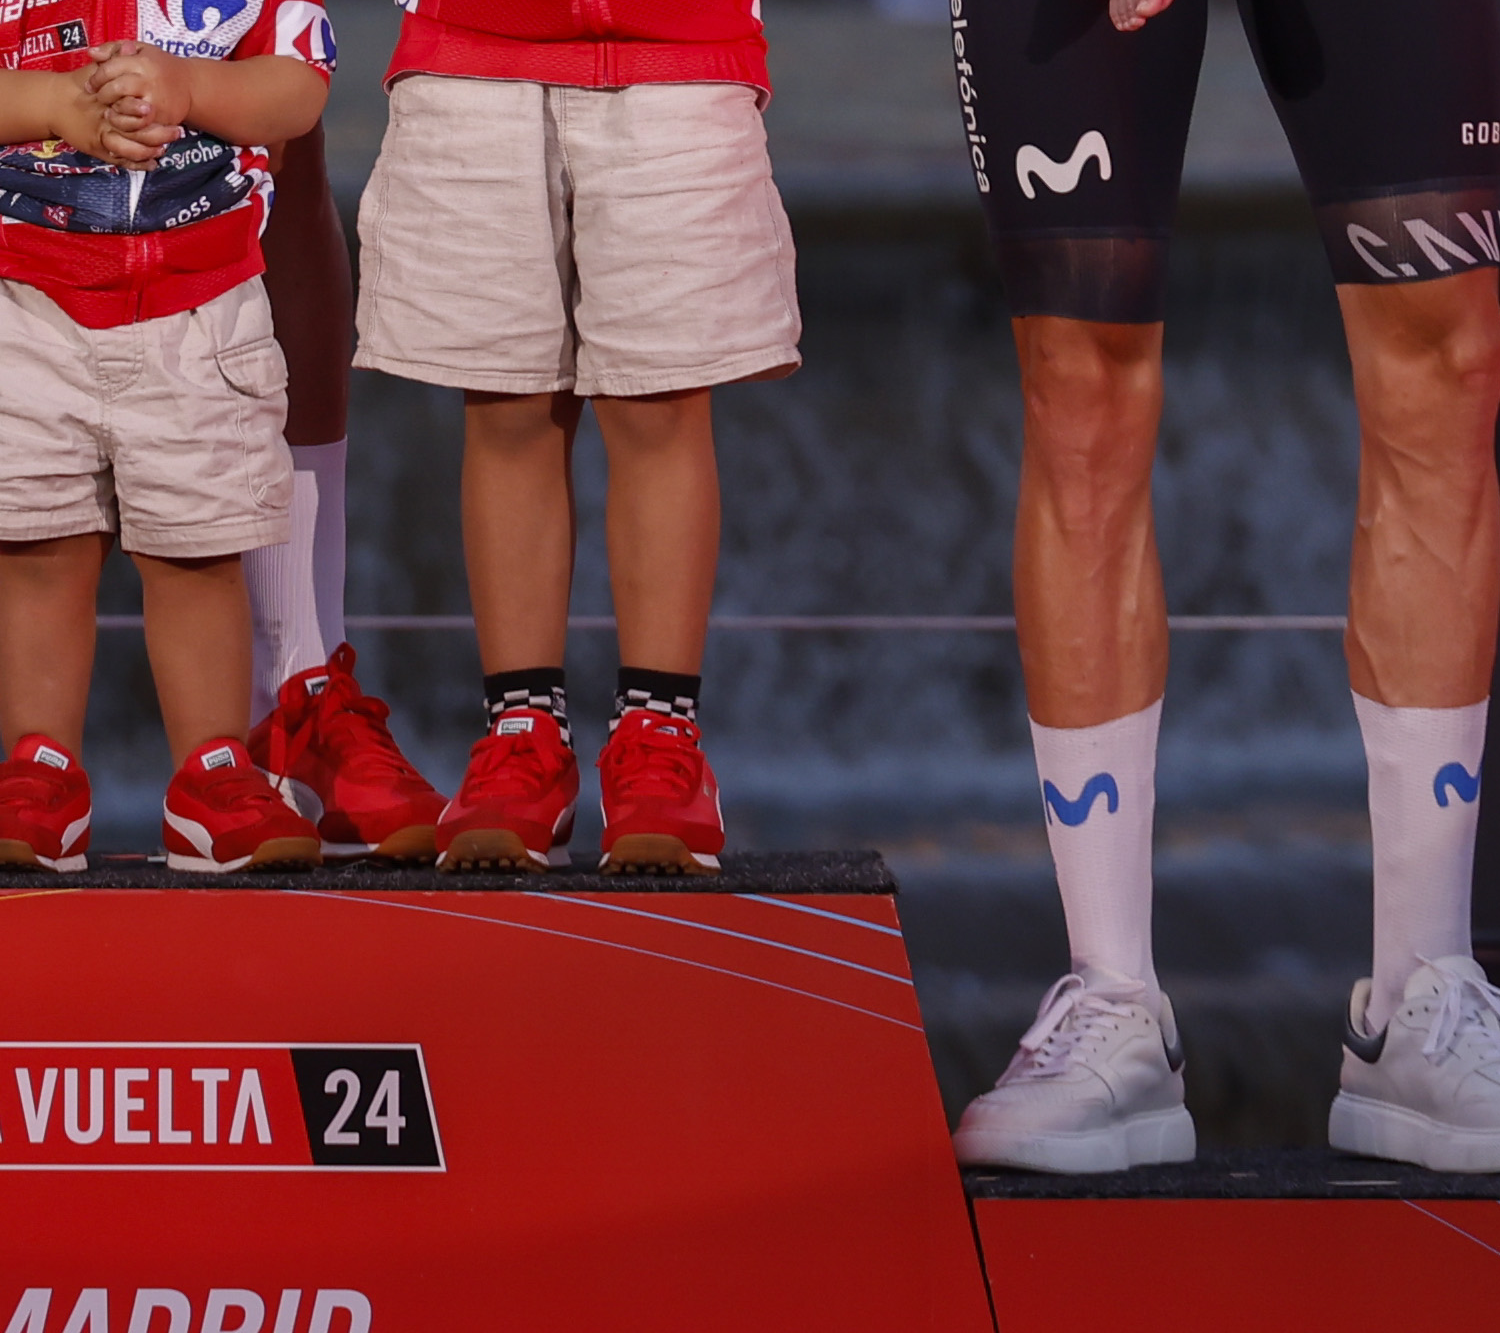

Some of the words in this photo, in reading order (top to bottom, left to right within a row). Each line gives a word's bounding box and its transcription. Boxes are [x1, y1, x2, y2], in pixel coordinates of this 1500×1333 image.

[63, 26, 80, 47] 24
[165, 196, 211, 229] BOSS
[15, 1067, 272, 1144] VUELTA
[323, 1068, 406, 1145] 24
